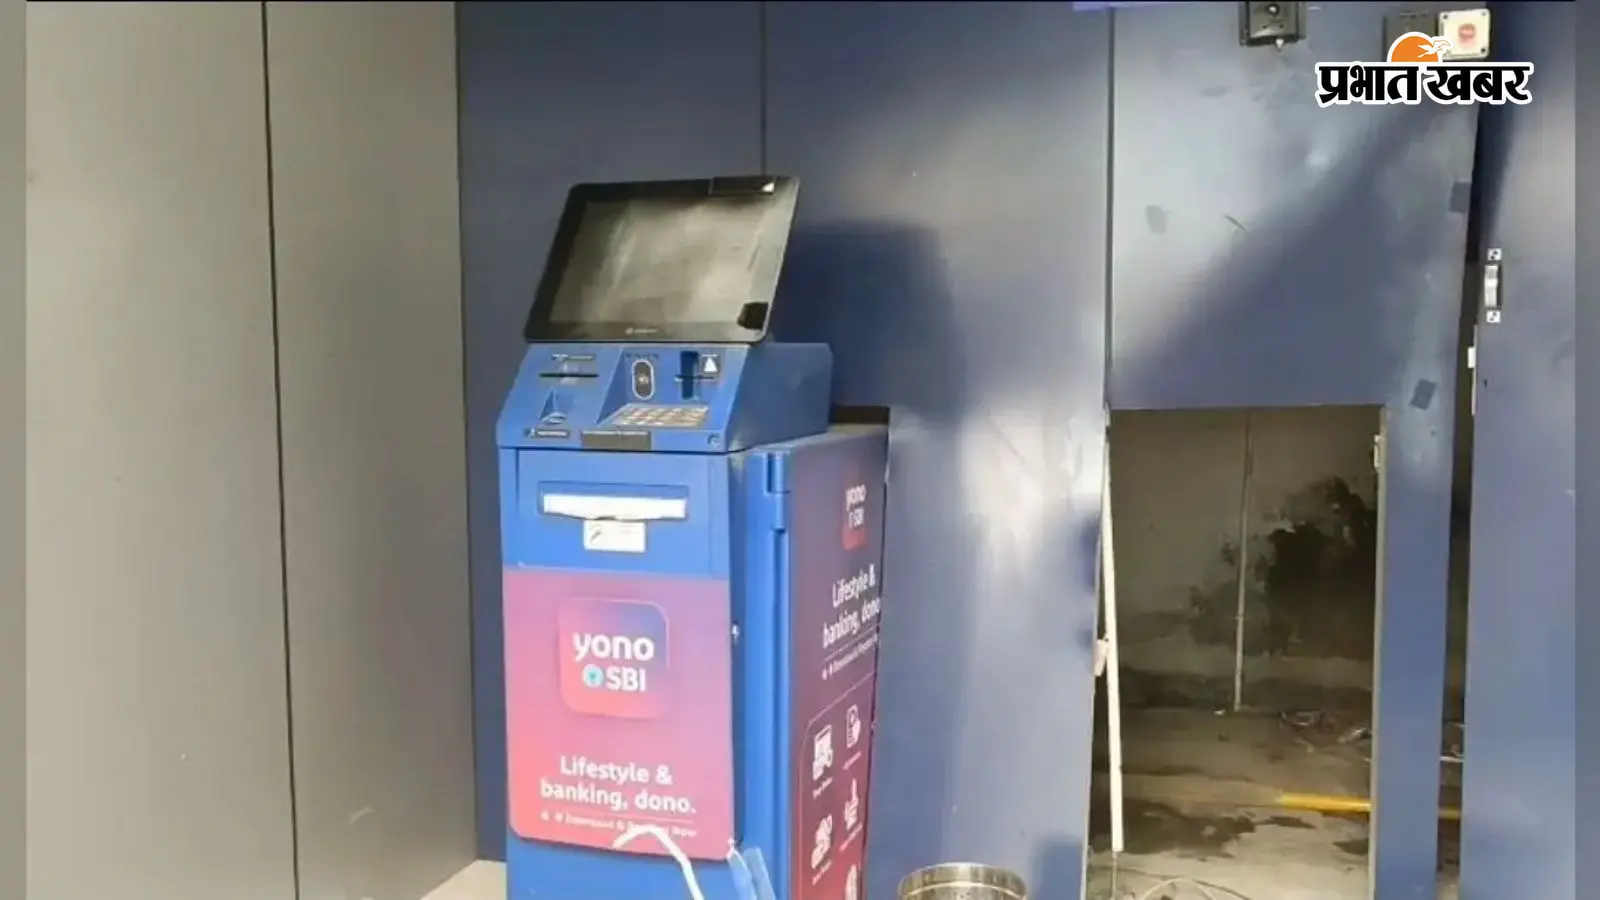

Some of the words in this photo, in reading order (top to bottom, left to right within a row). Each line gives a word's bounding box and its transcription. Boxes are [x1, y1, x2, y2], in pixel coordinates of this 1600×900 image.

[573, 633, 655, 662] yono
[606, 667, 647, 692] SBI
[560, 756, 650, 784] Lifestyle
[655, 765, 673, 784] &
[540, 778, 628, 811] banking,
[634, 791, 696, 814] dono.
